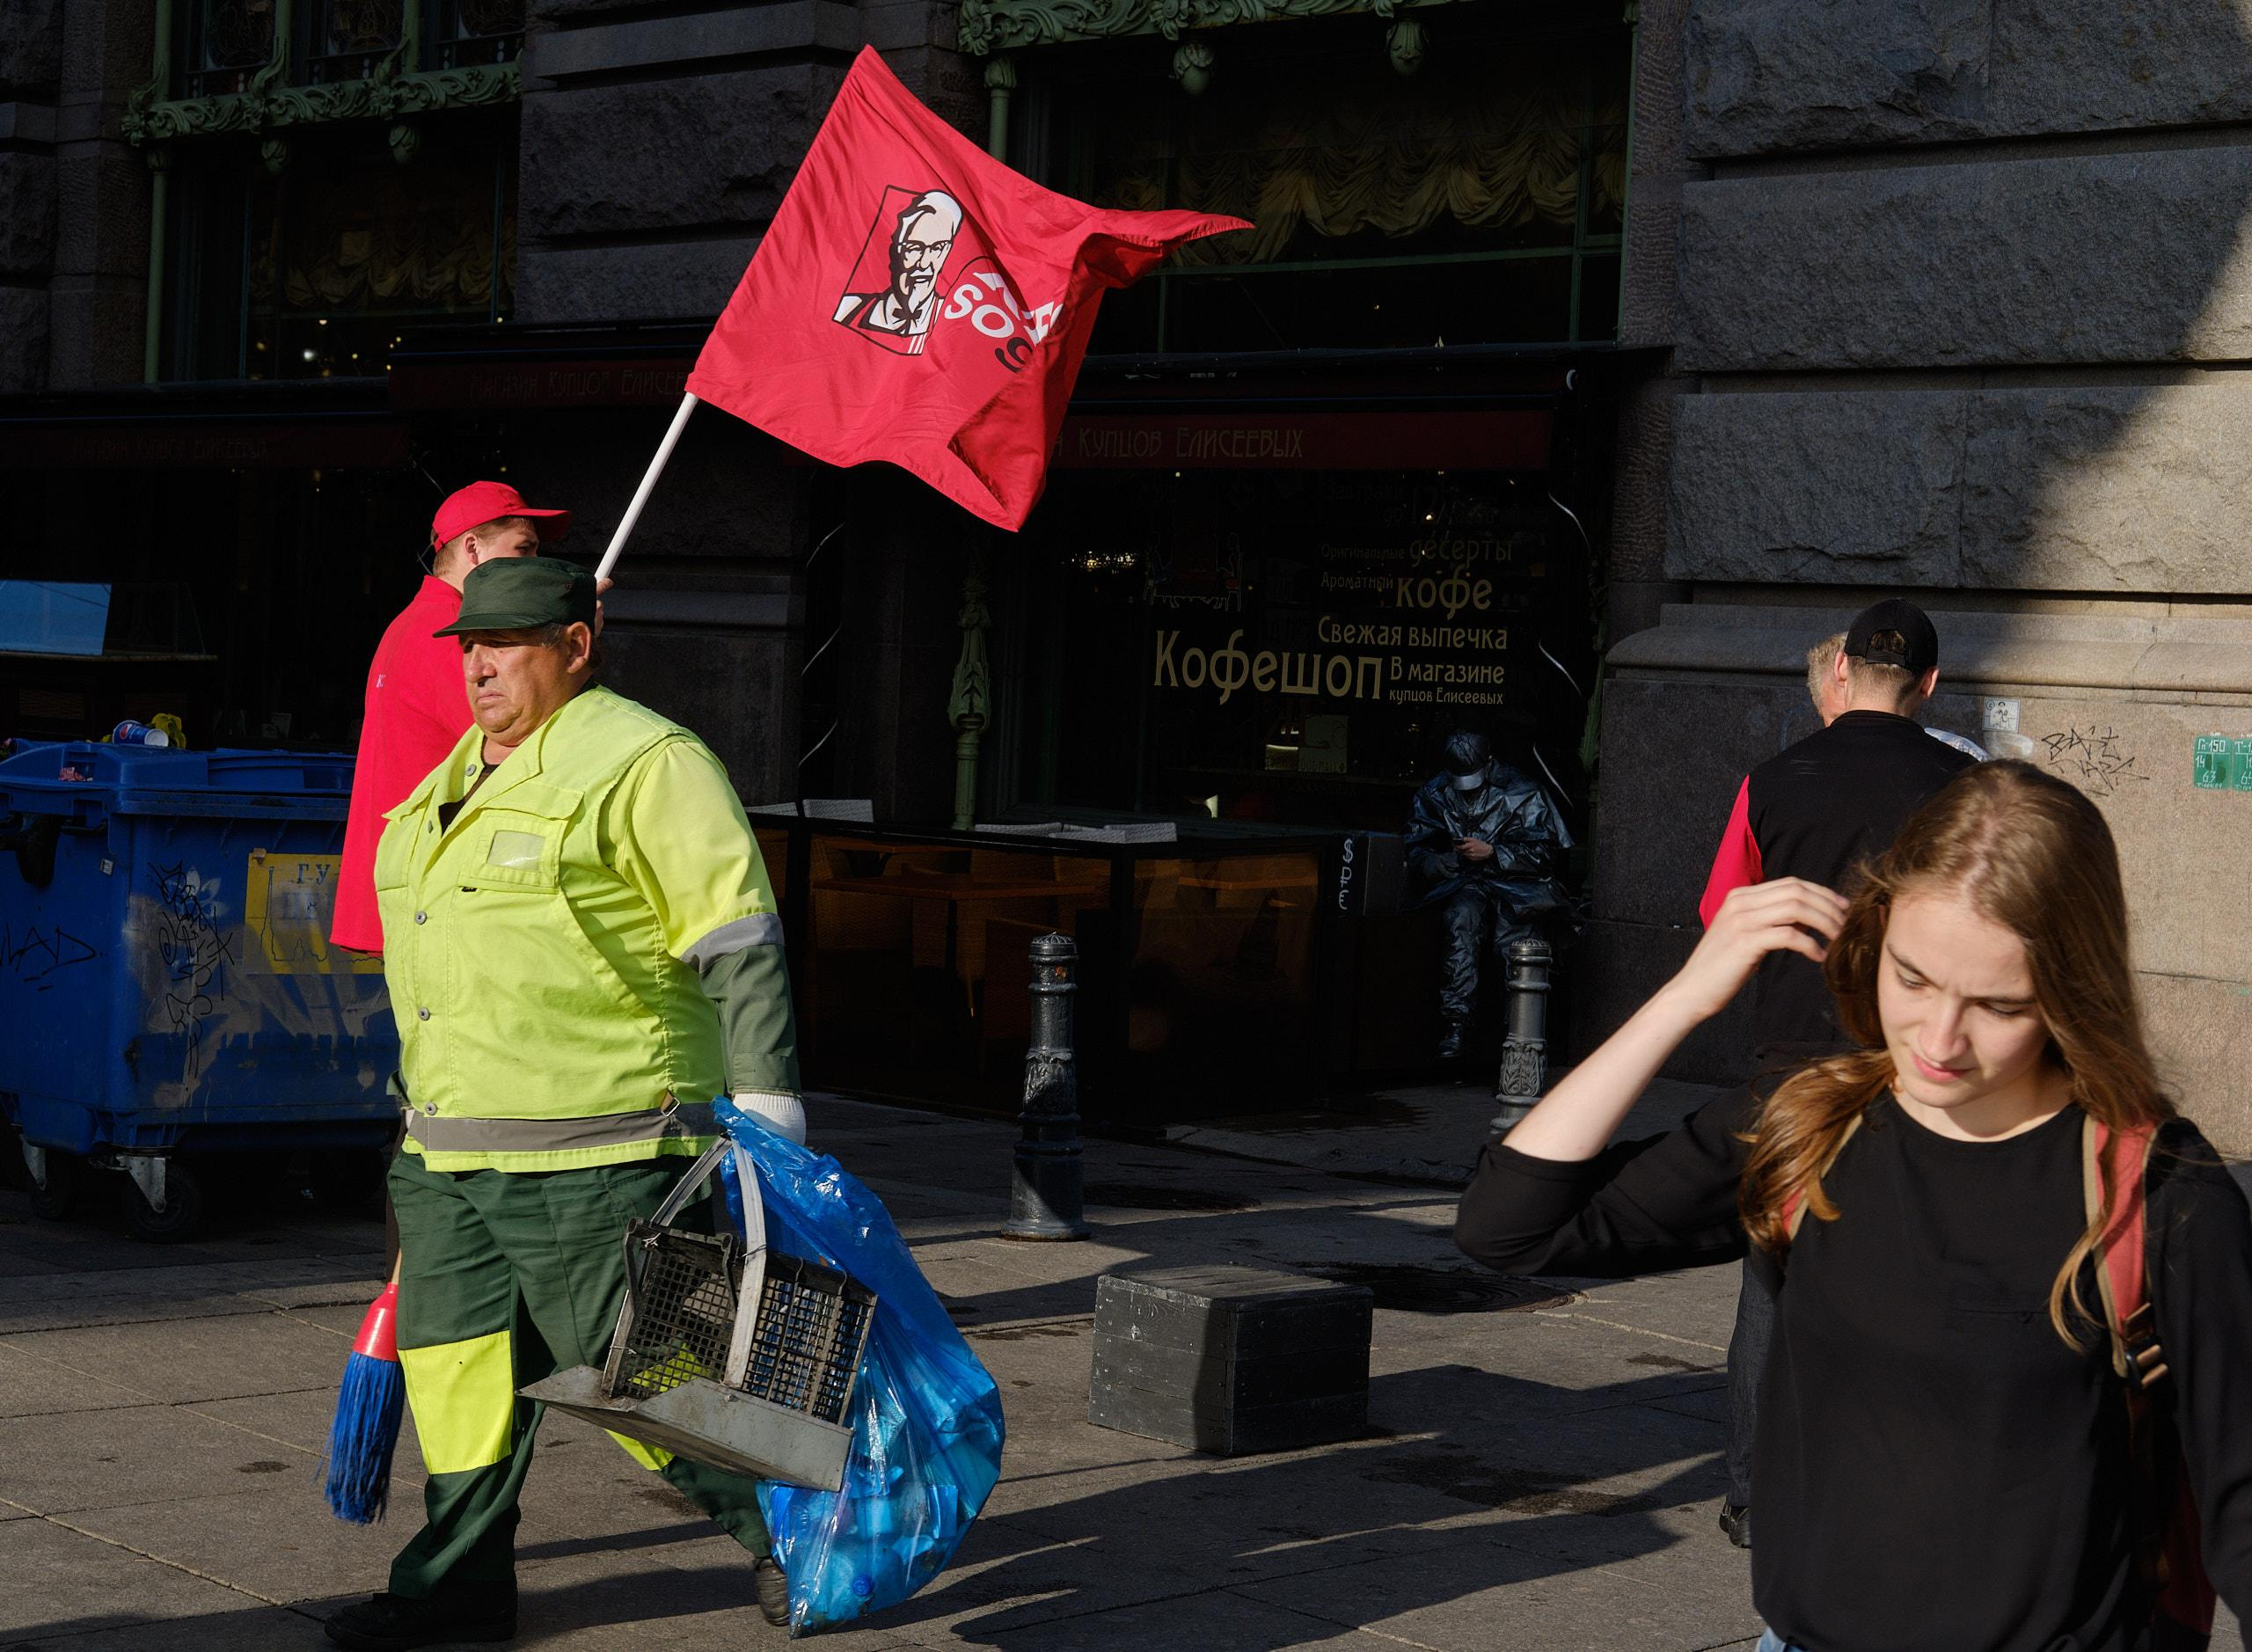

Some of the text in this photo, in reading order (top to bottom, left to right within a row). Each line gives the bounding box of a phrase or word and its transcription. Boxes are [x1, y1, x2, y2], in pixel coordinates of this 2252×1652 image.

[944, 282, 1014, 339] SO
[621, 368, 687, 396] ЕЛИСЕЕ
[1409, 538, 1514, 569] десерты
[1321, 563, 1492, 620] Ароматный кофе
[1318, 615, 1508, 650] Свежая выпечка
[1153, 628, 1384, 705] Кофешоп
[1389, 655, 1505, 685] В магазине
[1388, 686, 1504, 705] купцов Елисеевых
